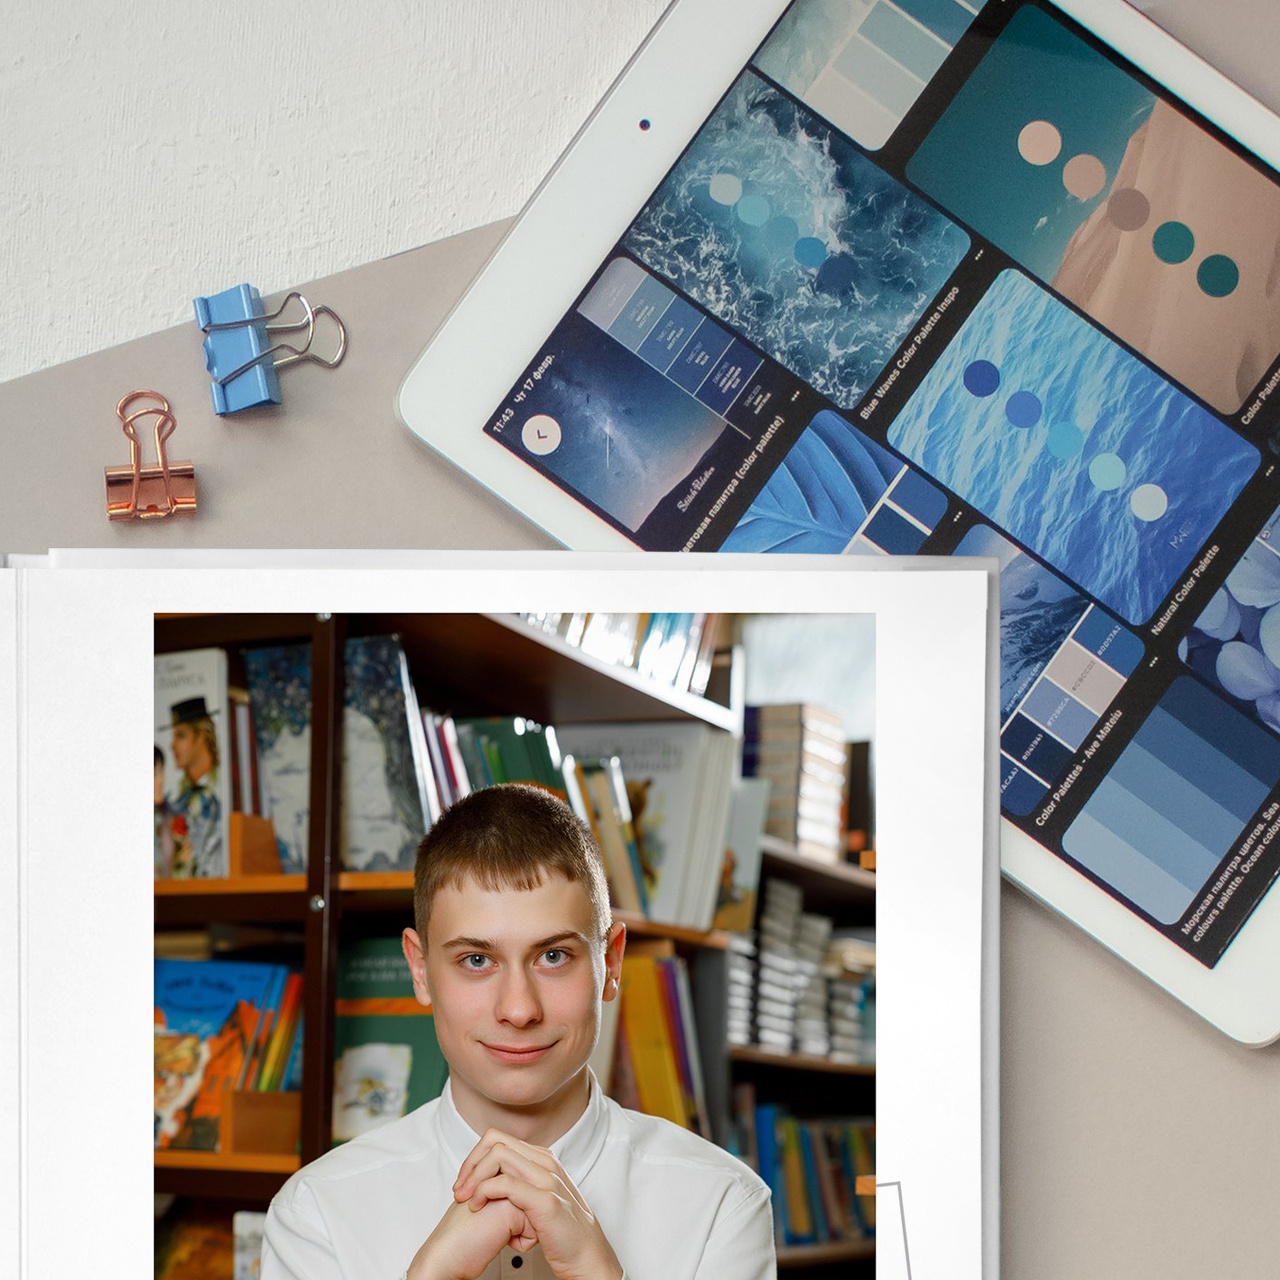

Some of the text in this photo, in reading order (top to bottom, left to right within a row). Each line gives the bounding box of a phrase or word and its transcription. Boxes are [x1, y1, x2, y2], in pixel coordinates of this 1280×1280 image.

[491, 351, 556, 434] 11:43 Чт 17 февр.
[858, 396, 879, 420] Blue
[874, 367, 900, 399] Waves
[895, 341, 919, 369] Color
[912, 310, 941, 345] Palette
[936, 284, 961, 314] Inspo
[1239, 397, 1263, 425] Color
[707, 478, 739, 518] палитра
[734, 449, 760, 479] (color
[753, 414, 785, 453] palette)
[1149, 599, 1179, 636] Natural
[1173, 575, 1196, 602] Color
[1191, 543, 1220, 577] Palette
[1033, 799, 1057, 827] Color
[1051, 762, 1084, 802] Palettes
[1082, 738, 1101, 759] Ave
[1180, 800, 1280, 935] Морская палитра цветов. Sea
[1190, 906, 1220, 942] colours
[1213, 871, 1246, 910] palette.
[1239, 842, 1266, 874] Ocean
